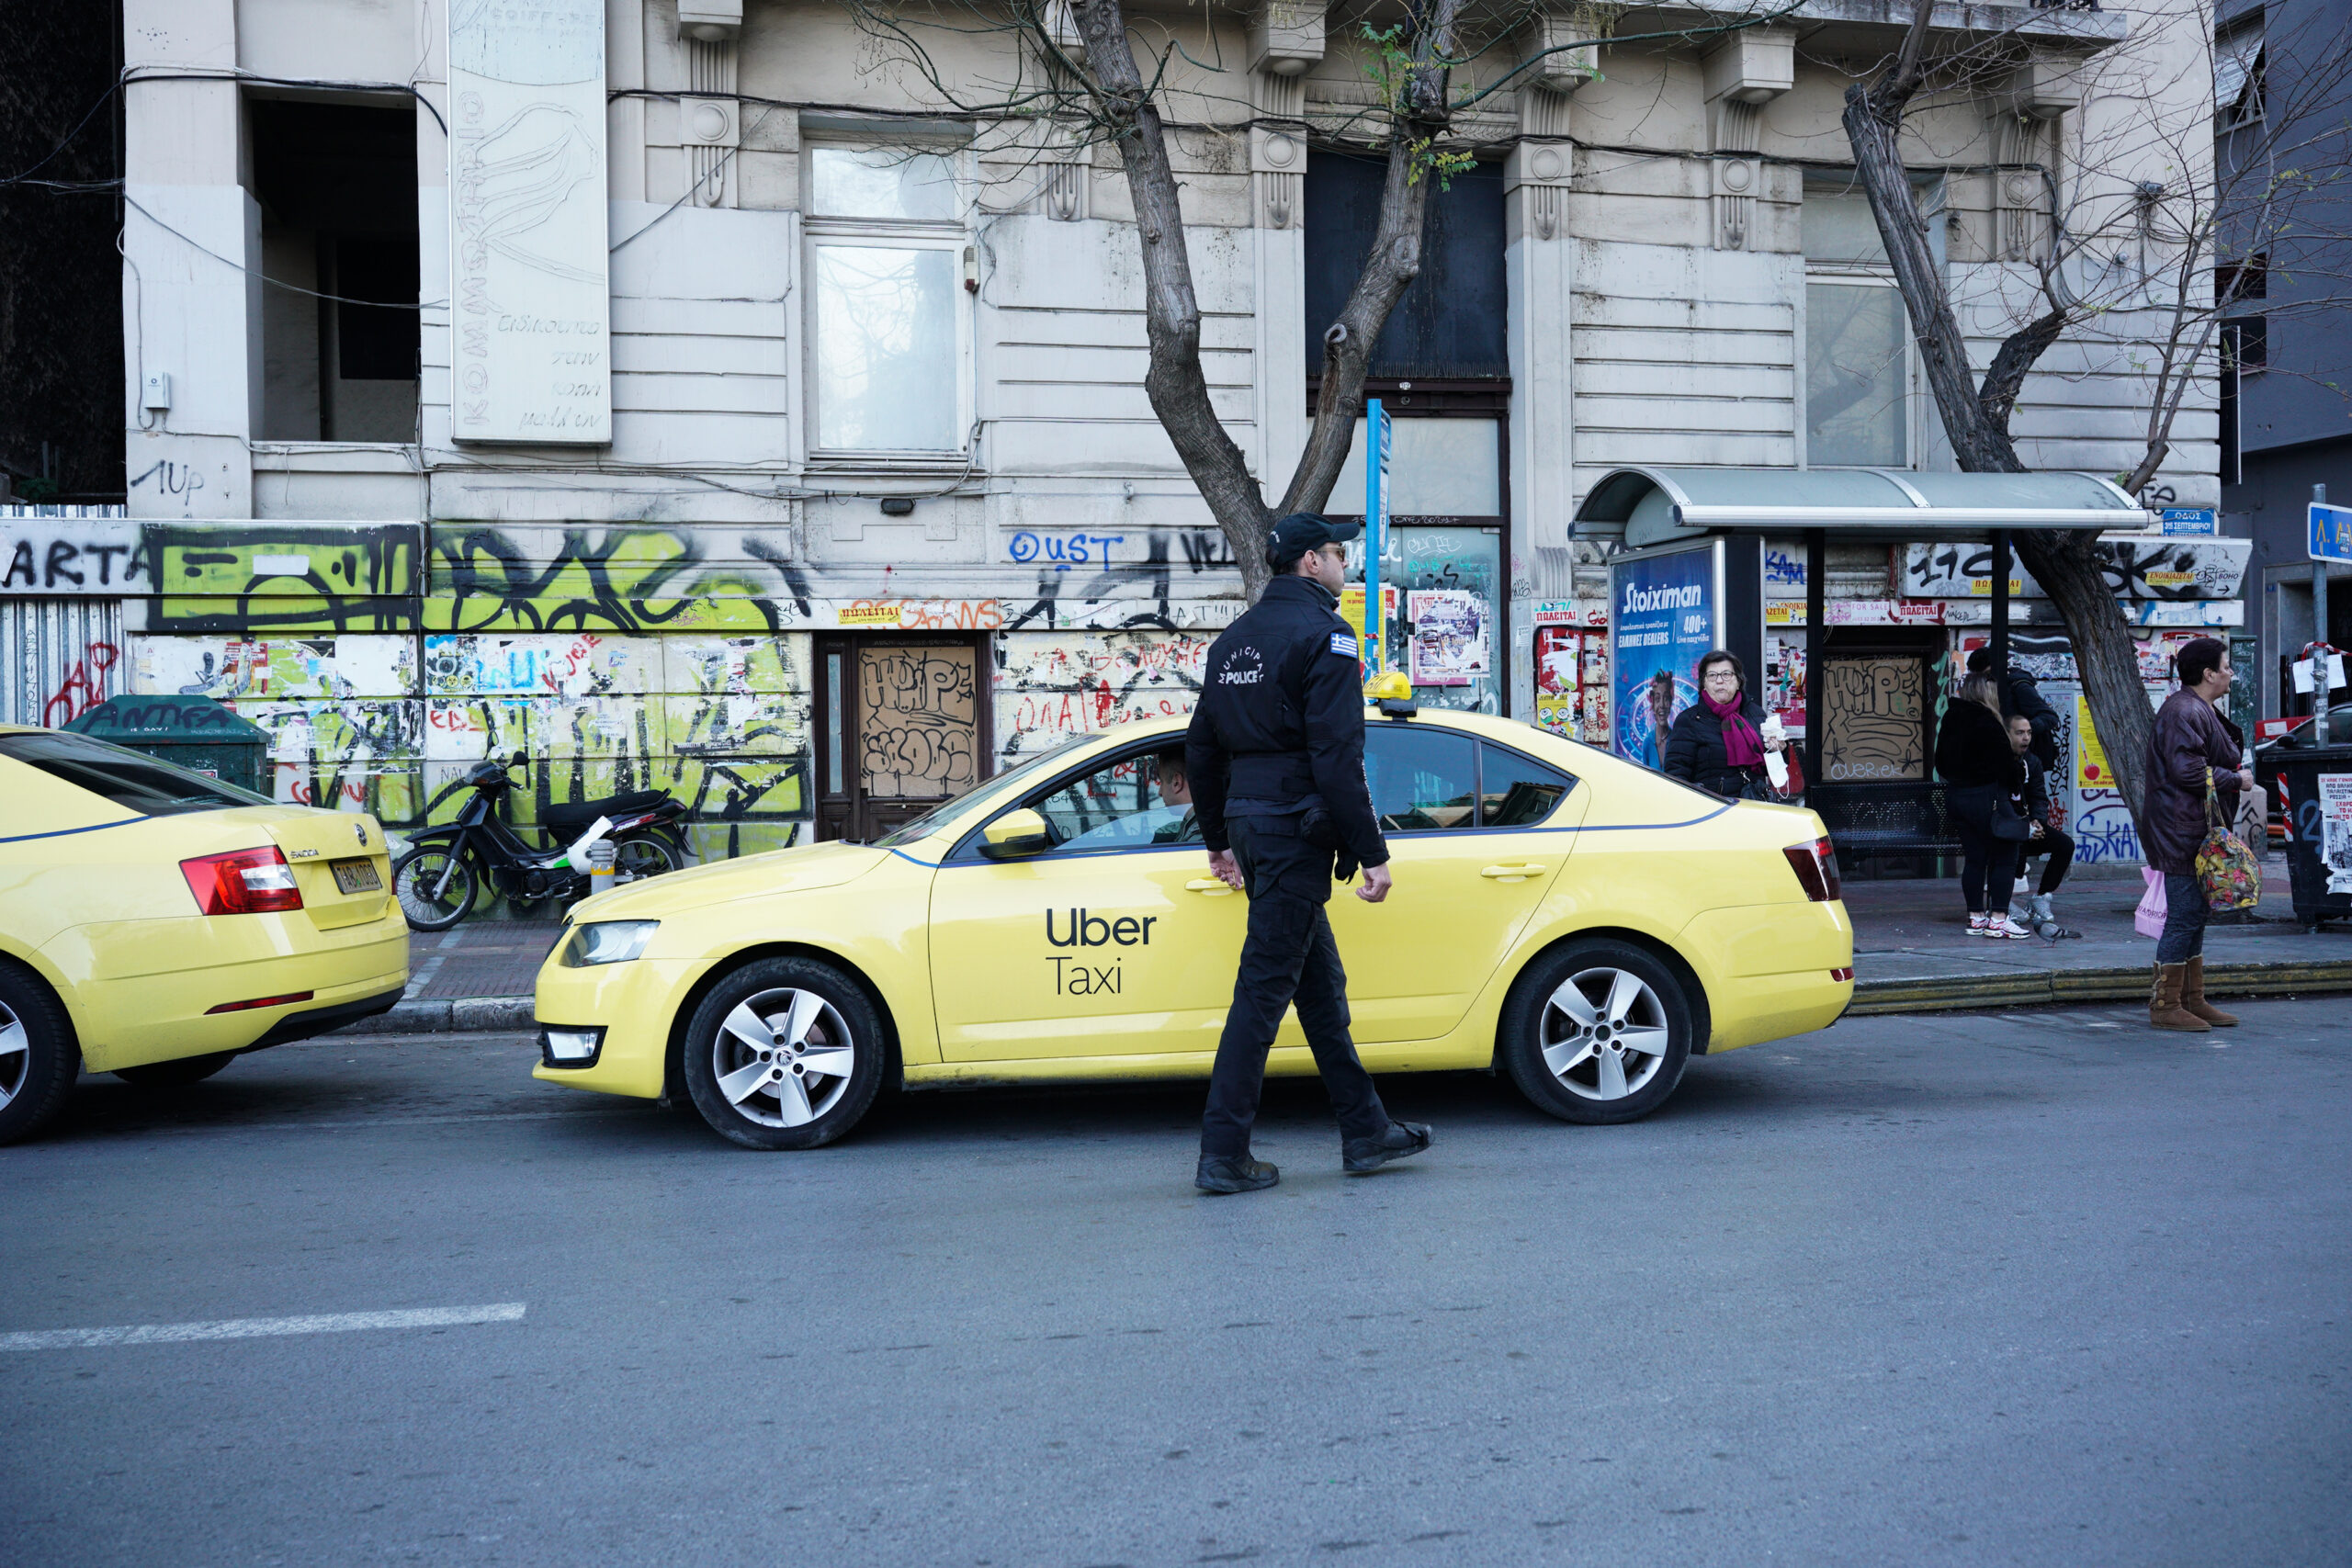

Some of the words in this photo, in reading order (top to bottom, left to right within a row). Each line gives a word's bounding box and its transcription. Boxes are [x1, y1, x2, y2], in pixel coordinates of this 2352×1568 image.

[2175, 512, 2200, 520] ΟΔΟΣ
[2174, 522, 2211, 530] ΣΕΠΤΕΜΒΡΙΟΥ
[2150, 572, 2193, 581] ΕΝΟΙΚΙΑΖΕΤΑΙ
[1975, 580, 2020, 588] ΠΩΑΙ
[1623, 582, 1702, 614] Stoiximan
[842, 607, 899, 617] ΠΩΛΕΙΤΑΙ
[1851, 603, 1867, 611] FOR
[1900, 605, 1936, 616] ΠΩΛΕΙΤΑΙ
[1535, 611, 1577, 622] ΠΩΛΕΙΤΑΙ
[1683, 615, 1707, 633] 400+
[1643, 632, 1668, 646] DEALERS
[1217, 646, 1263, 684] MUNICIPAL
[1226, 670, 1258, 684] POLICE
[81, 704, 231, 733] ANTIFA
[1046, 908, 1157, 946] Uber
[1046, 957, 1122, 995] Taxi
